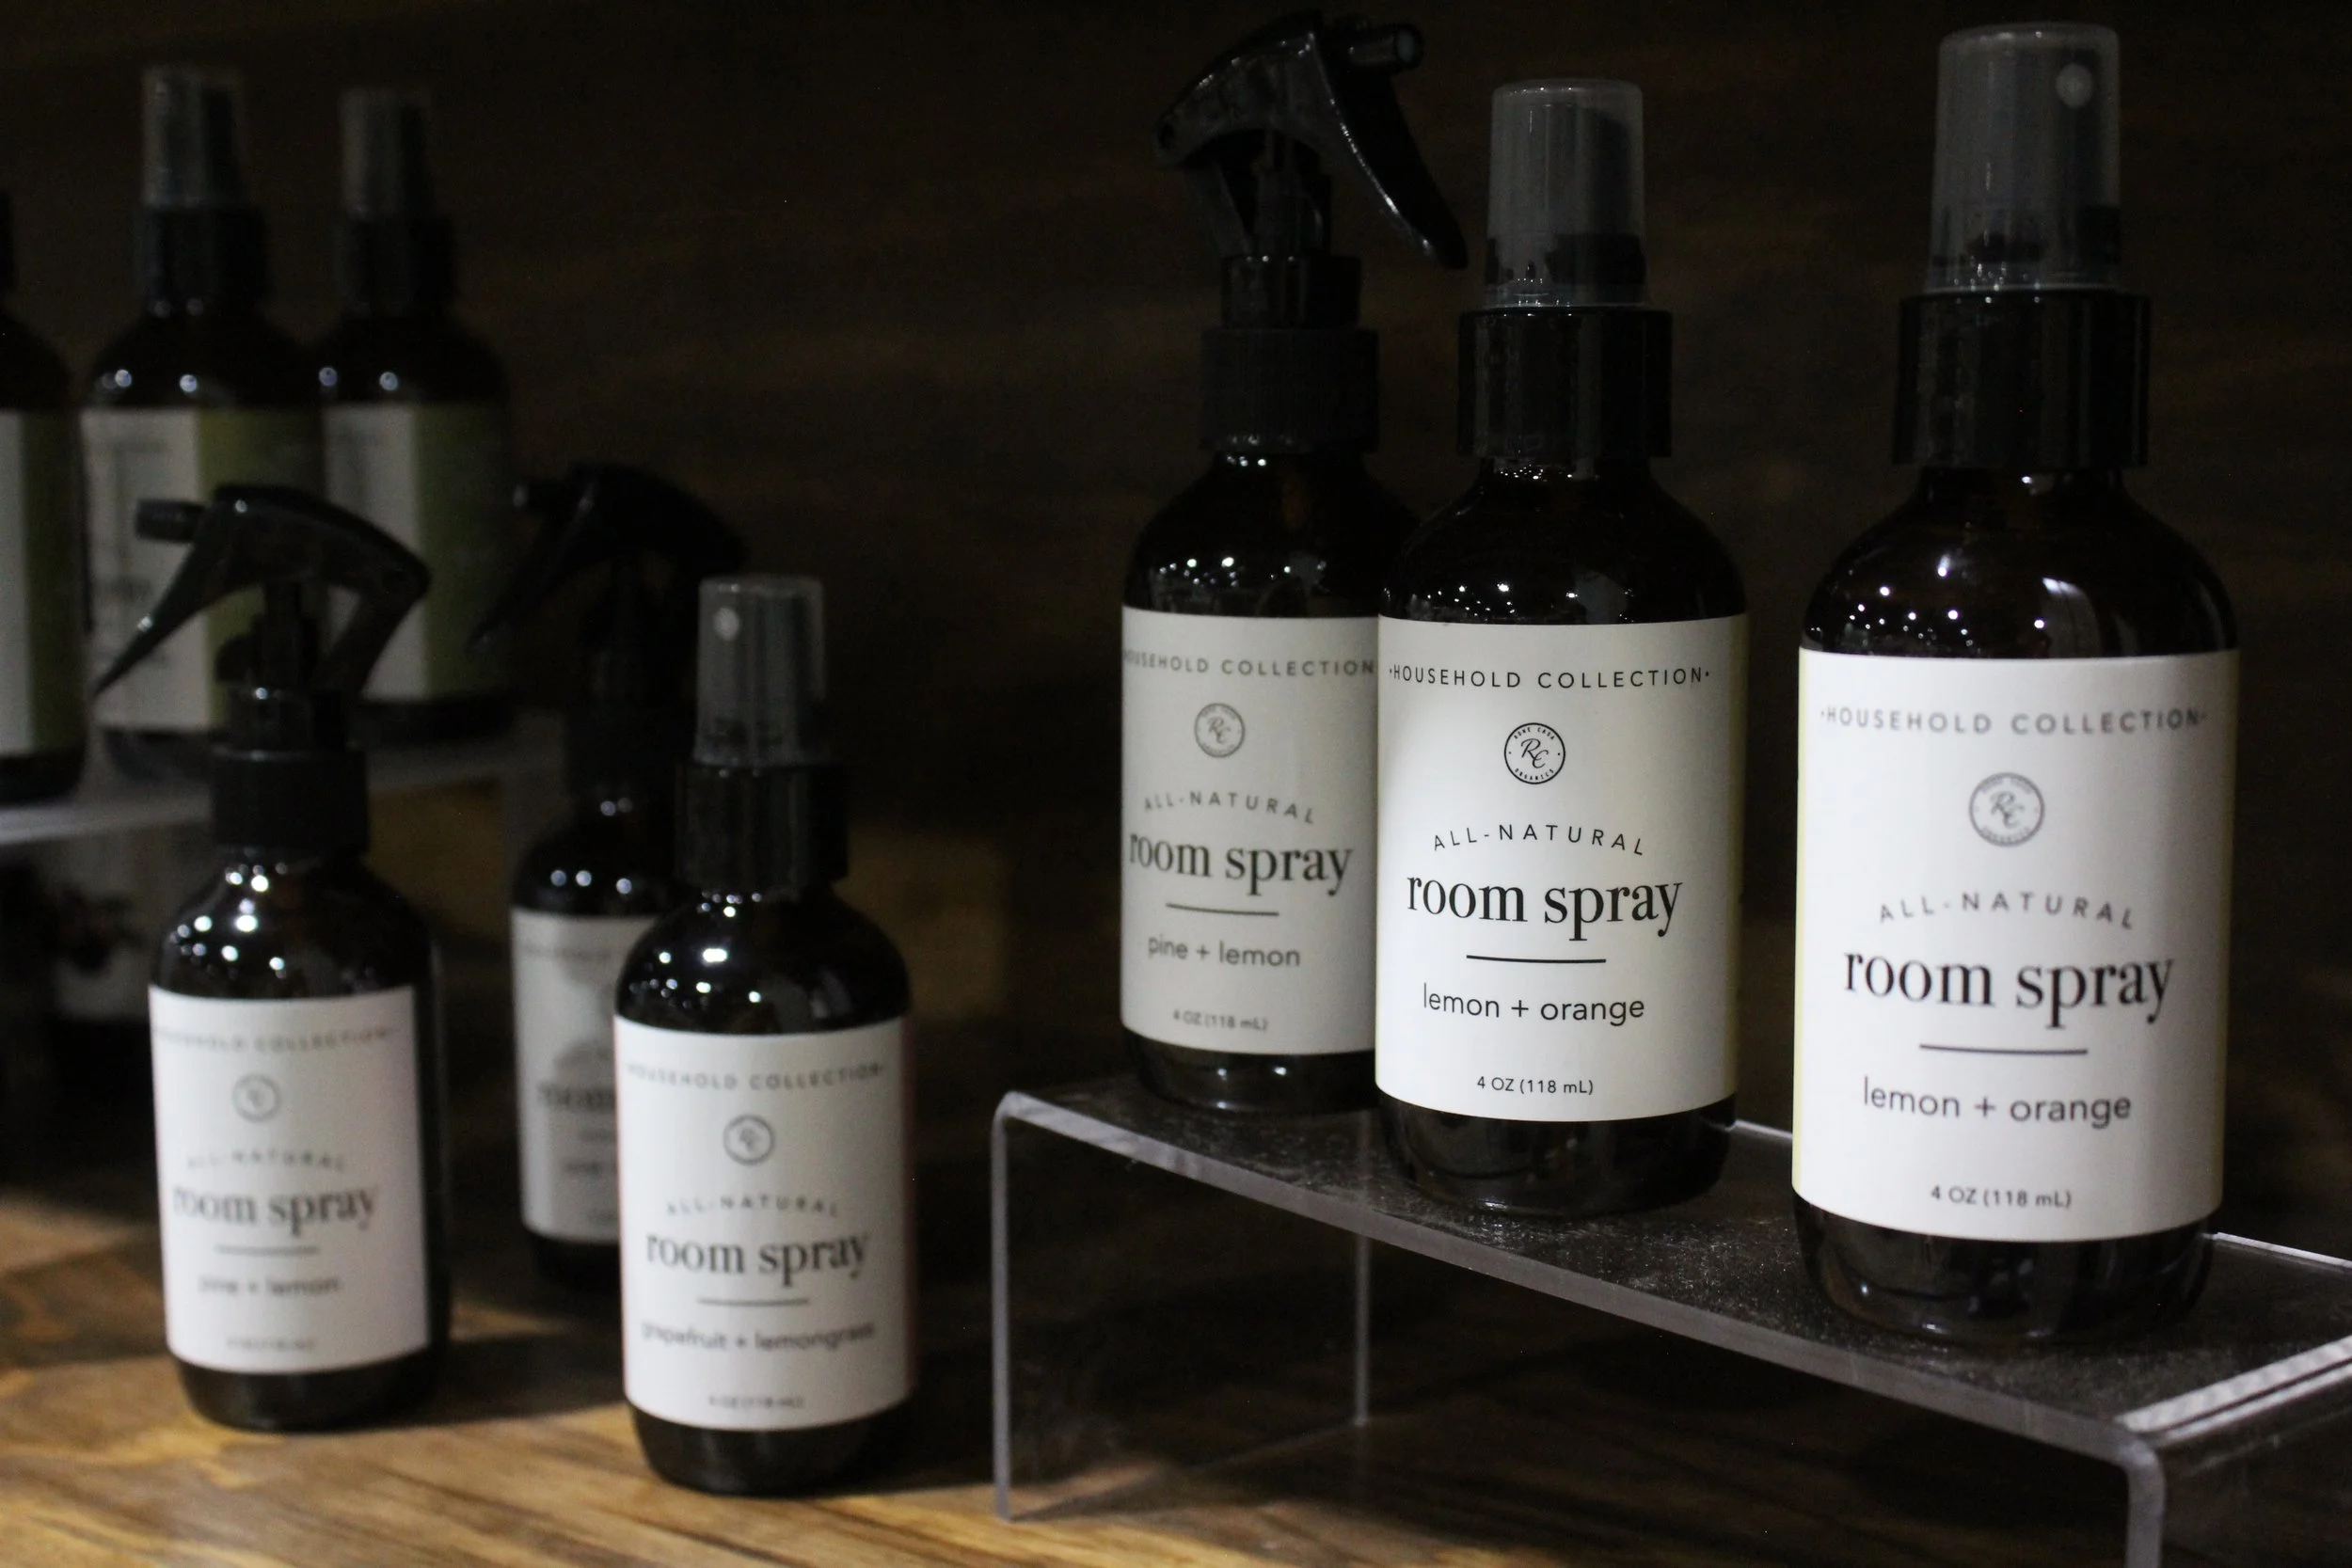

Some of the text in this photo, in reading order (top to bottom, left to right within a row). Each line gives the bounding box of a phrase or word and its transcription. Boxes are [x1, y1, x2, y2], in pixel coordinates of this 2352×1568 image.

[1221, 658, 1375, 677] COLLECTION
[1393, 664, 1703, 689] HOUSEHOLD COLLECTION
[1825, 705, 2201, 736] HOUSEHOLD COLLECTION
[1144, 791, 1314, 825] ALL-NATURAL
[1433, 823, 1645, 857] ALL-NATURAL
[1129, 832, 1354, 897] room spray
[1406, 875, 1684, 942] room spray
[1880, 892, 2134, 930] ALL-NATURAL
[1148, 933, 1189, 960] pine
[1219, 940, 1301, 967] lemon
[1423, 981, 1646, 1027] lemon + orange
[1844, 950, 2175, 1030] room spray
[1477, 1075, 1595, 1098] 4 OZ (118 mL)
[1864, 1075, 2133, 1131] lemon + orange
[267, 1183, 378, 1239] spray
[1930, 1185, 2073, 1211] 4 OZ (118 mL)
[645, 1230, 870, 1290] room spray
